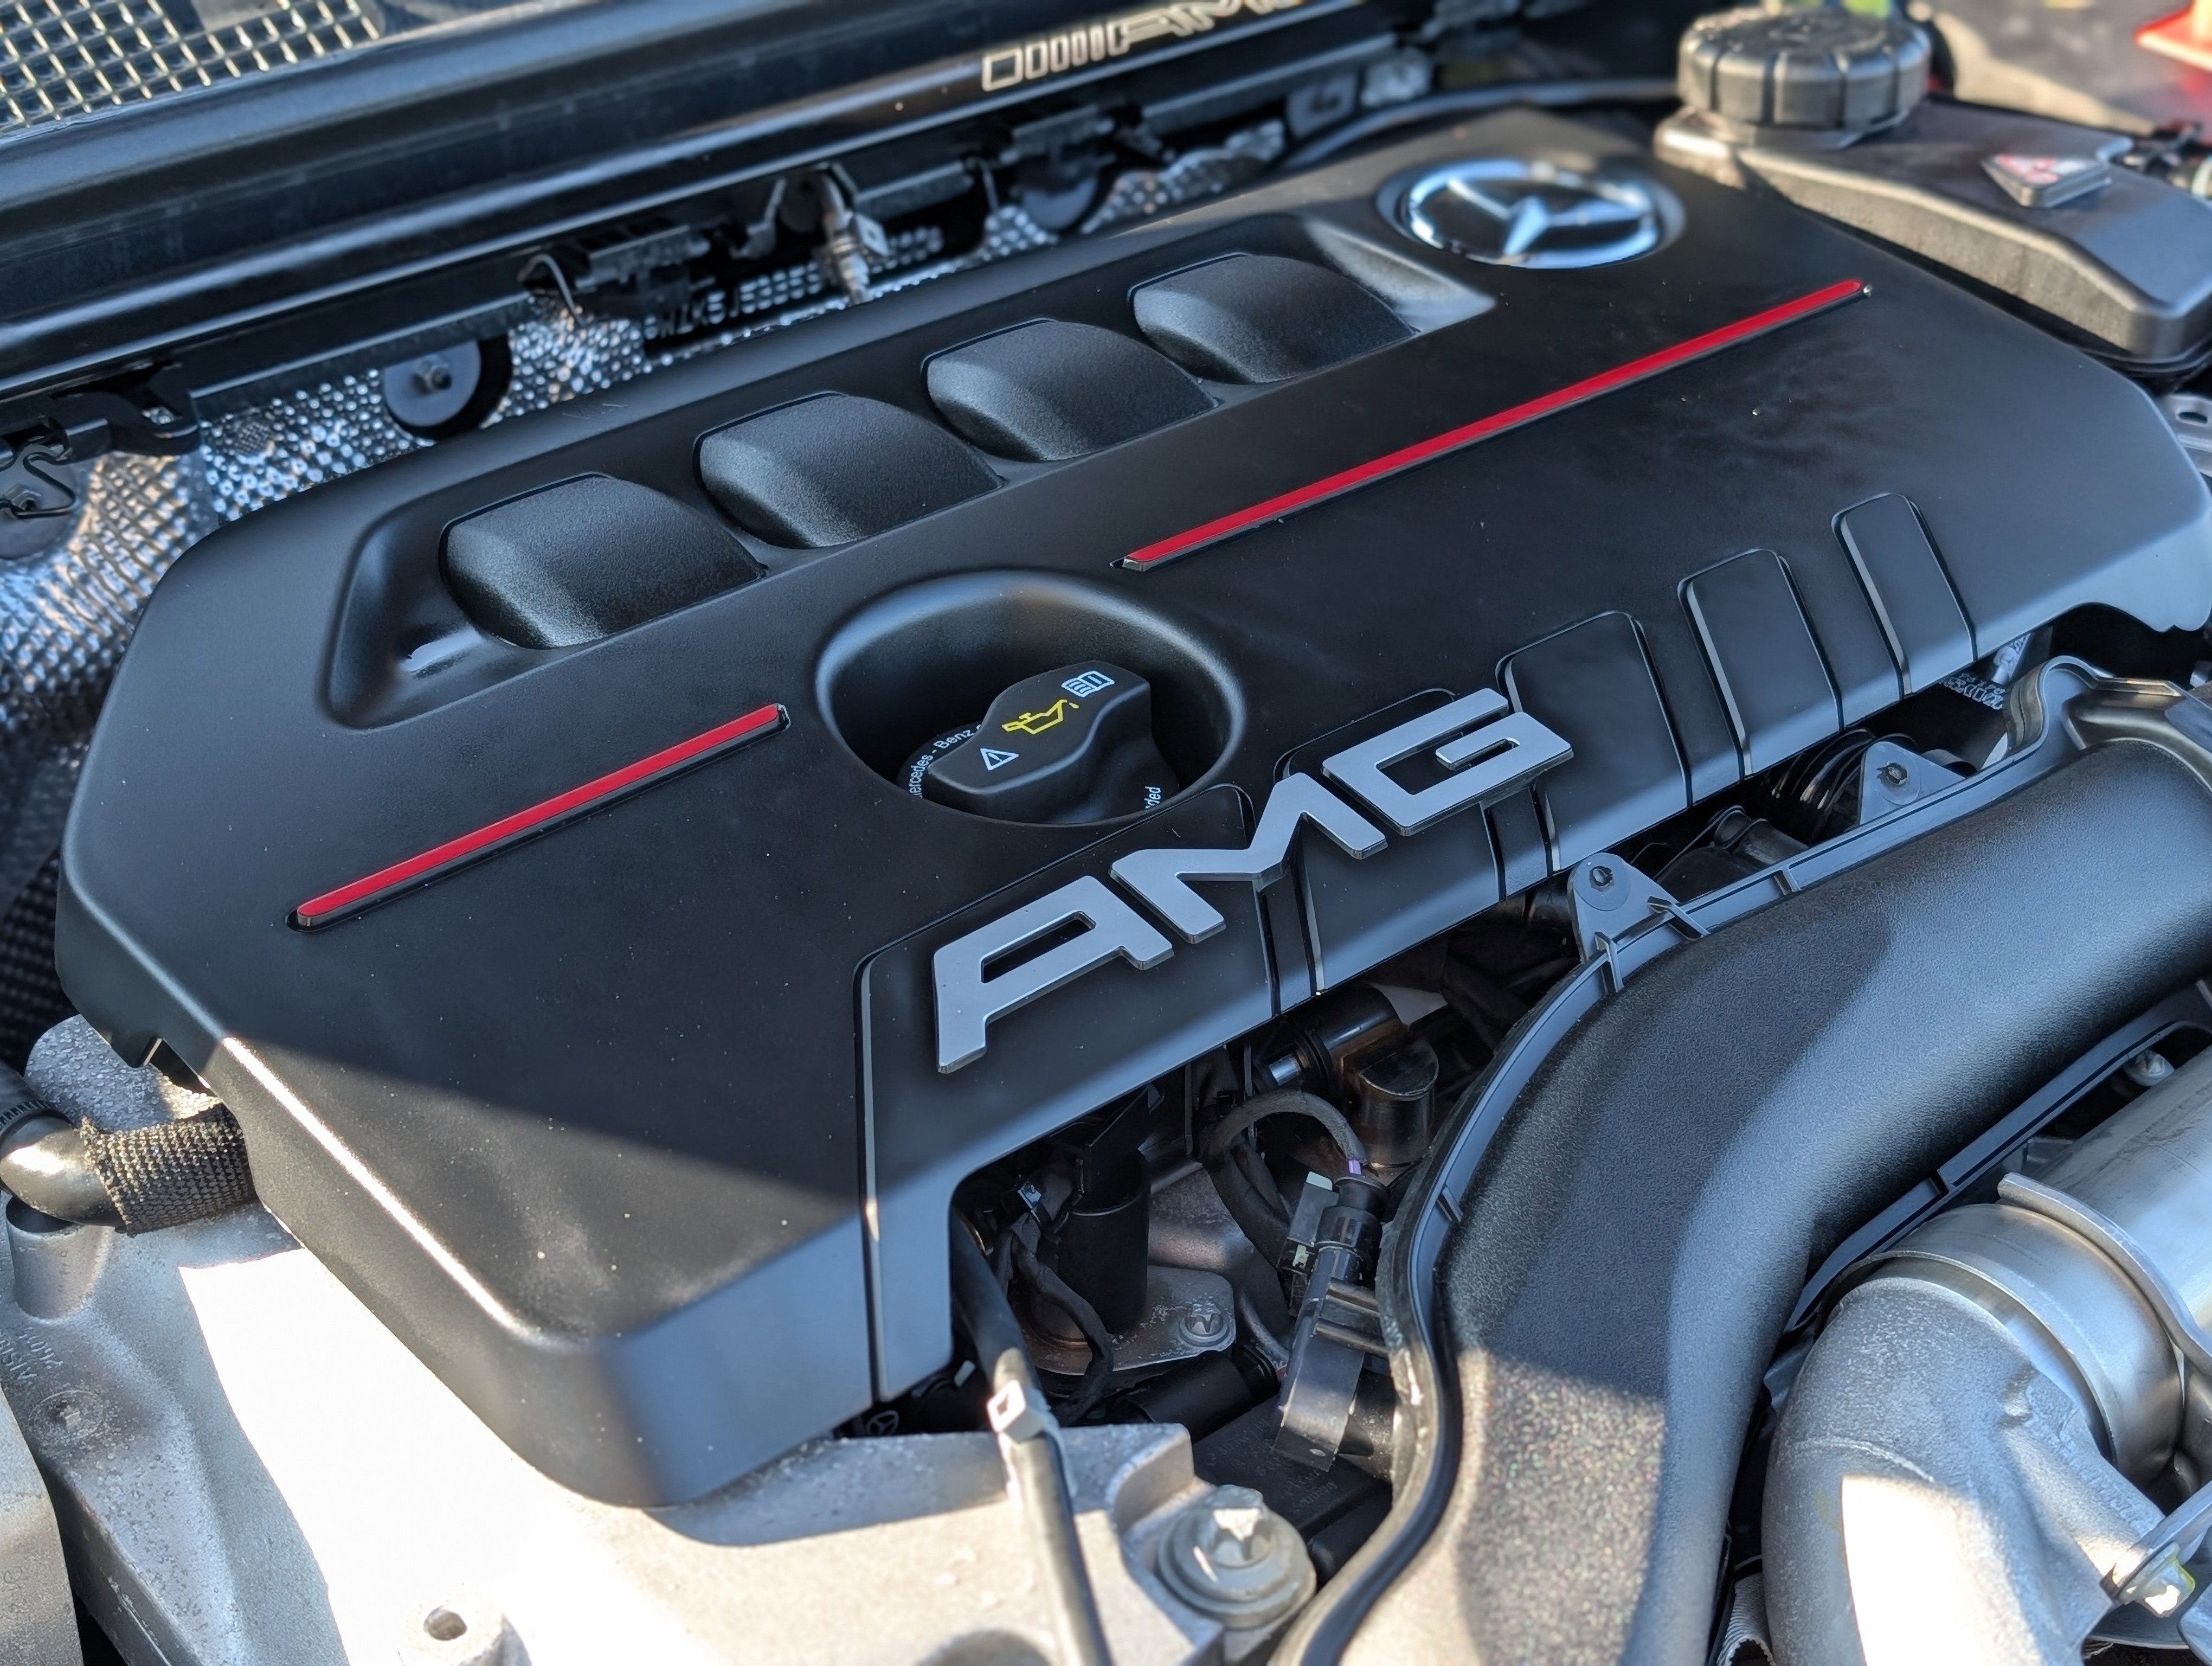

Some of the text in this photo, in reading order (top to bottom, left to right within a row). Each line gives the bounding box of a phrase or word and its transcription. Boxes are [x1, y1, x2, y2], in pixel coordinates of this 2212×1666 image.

[909, 754, 934, 798] ercedes
[934, 729, 976, 749] Benz
[933, 688, 1574, 1074] AMG
